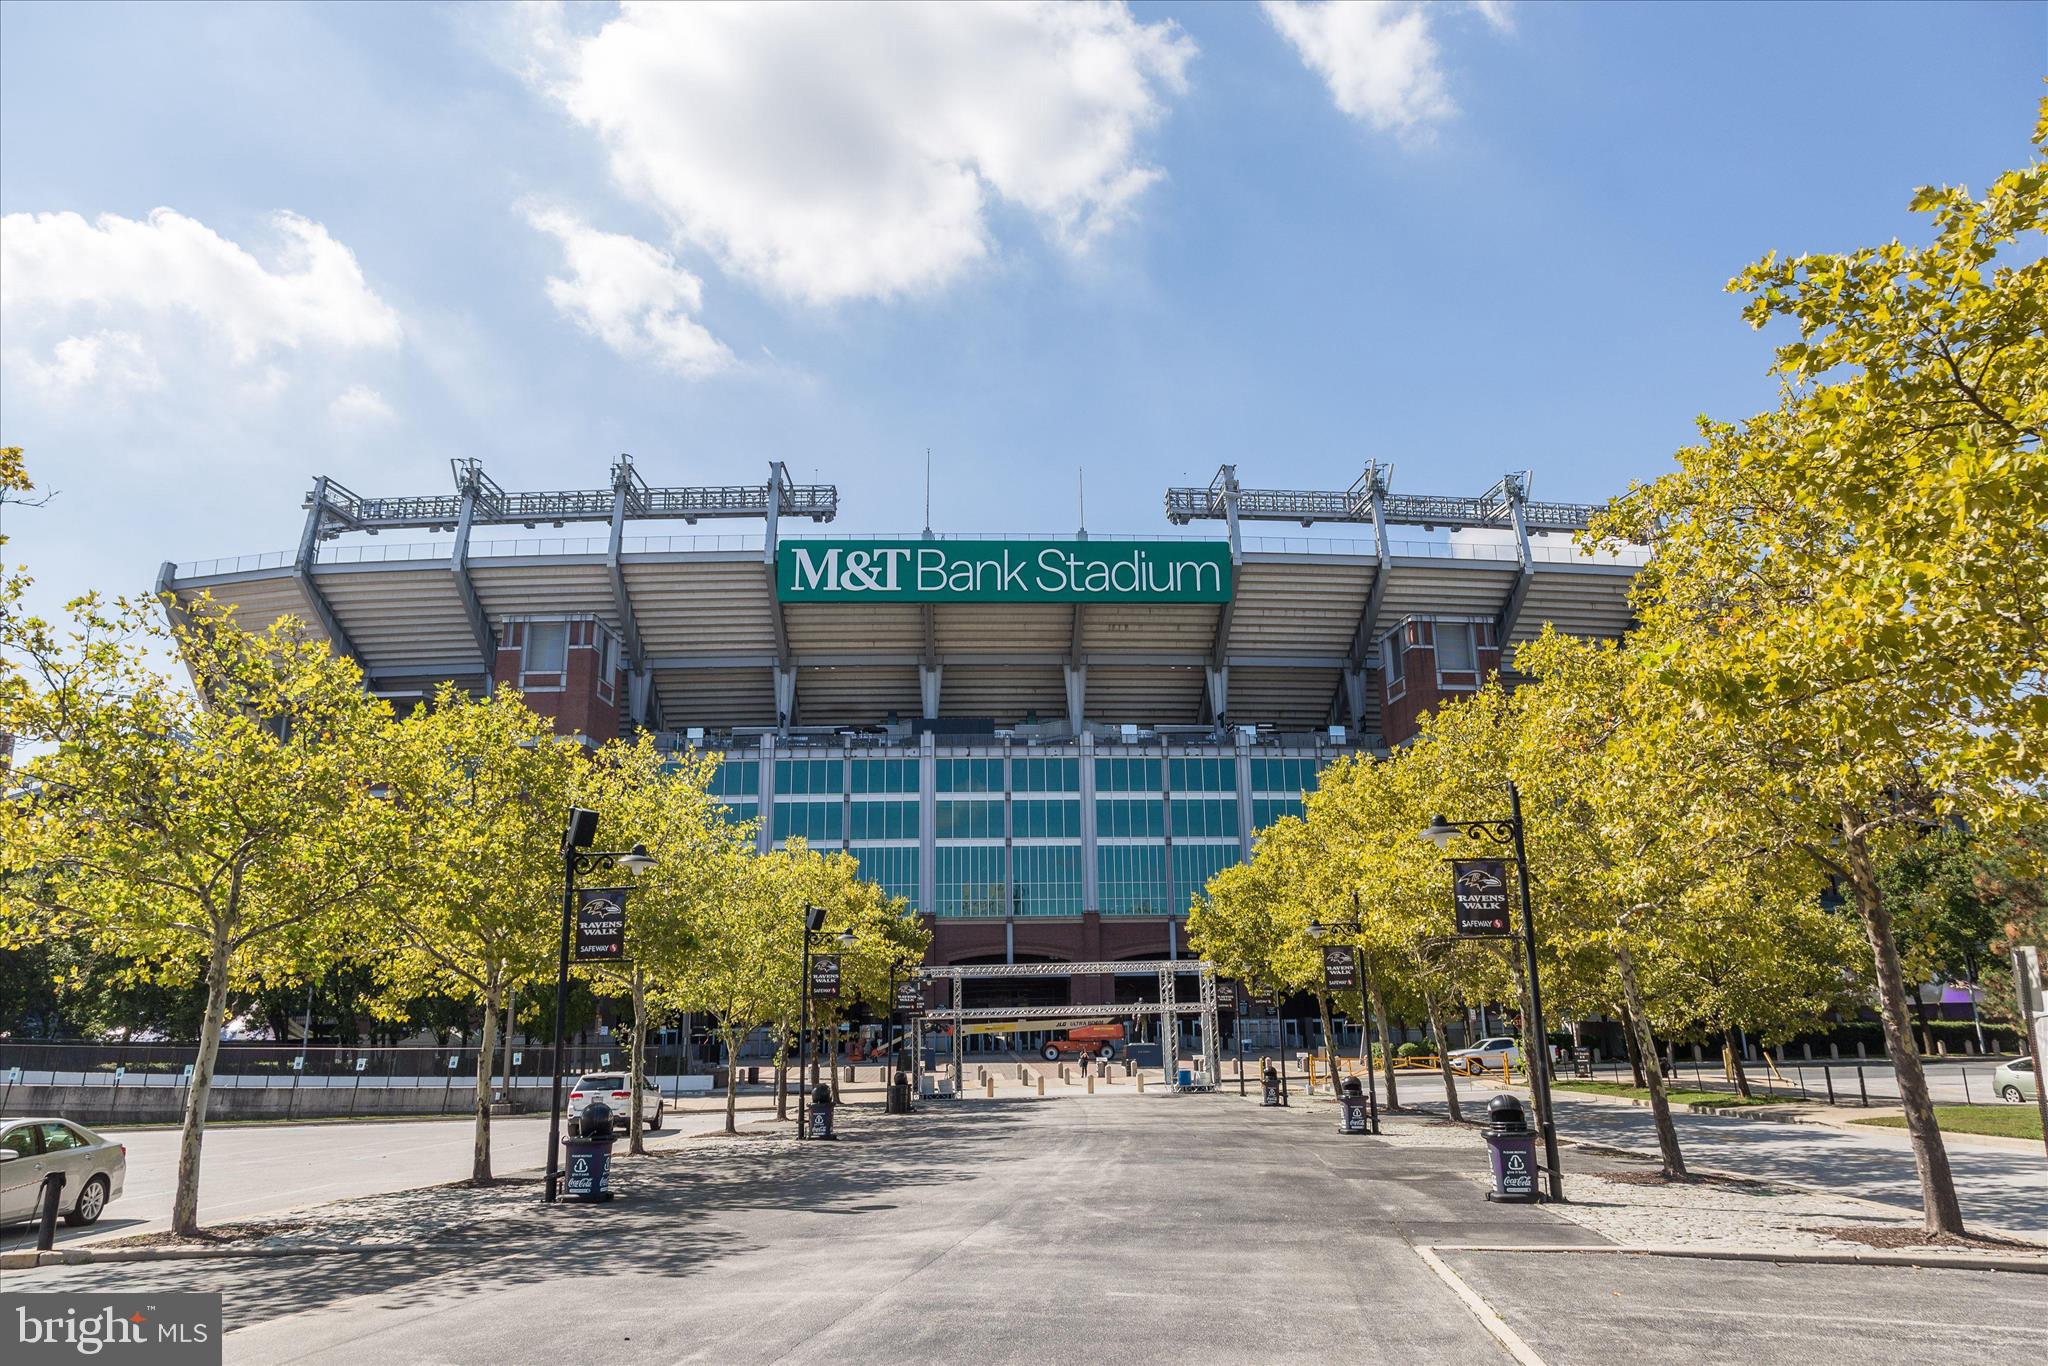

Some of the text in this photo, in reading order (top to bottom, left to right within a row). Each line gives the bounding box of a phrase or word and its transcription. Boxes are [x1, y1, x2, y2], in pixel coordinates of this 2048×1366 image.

[790, 548, 1221, 592] M&T Bank Stadium
[1457, 894, 1506, 902] RAVENS
[579, 921, 623, 929] RAVENS
[1461, 919, 1493, 927] SAFEWAY
[583, 928, 618, 936] WALK
[580, 945, 609, 953] SAFEWAY
